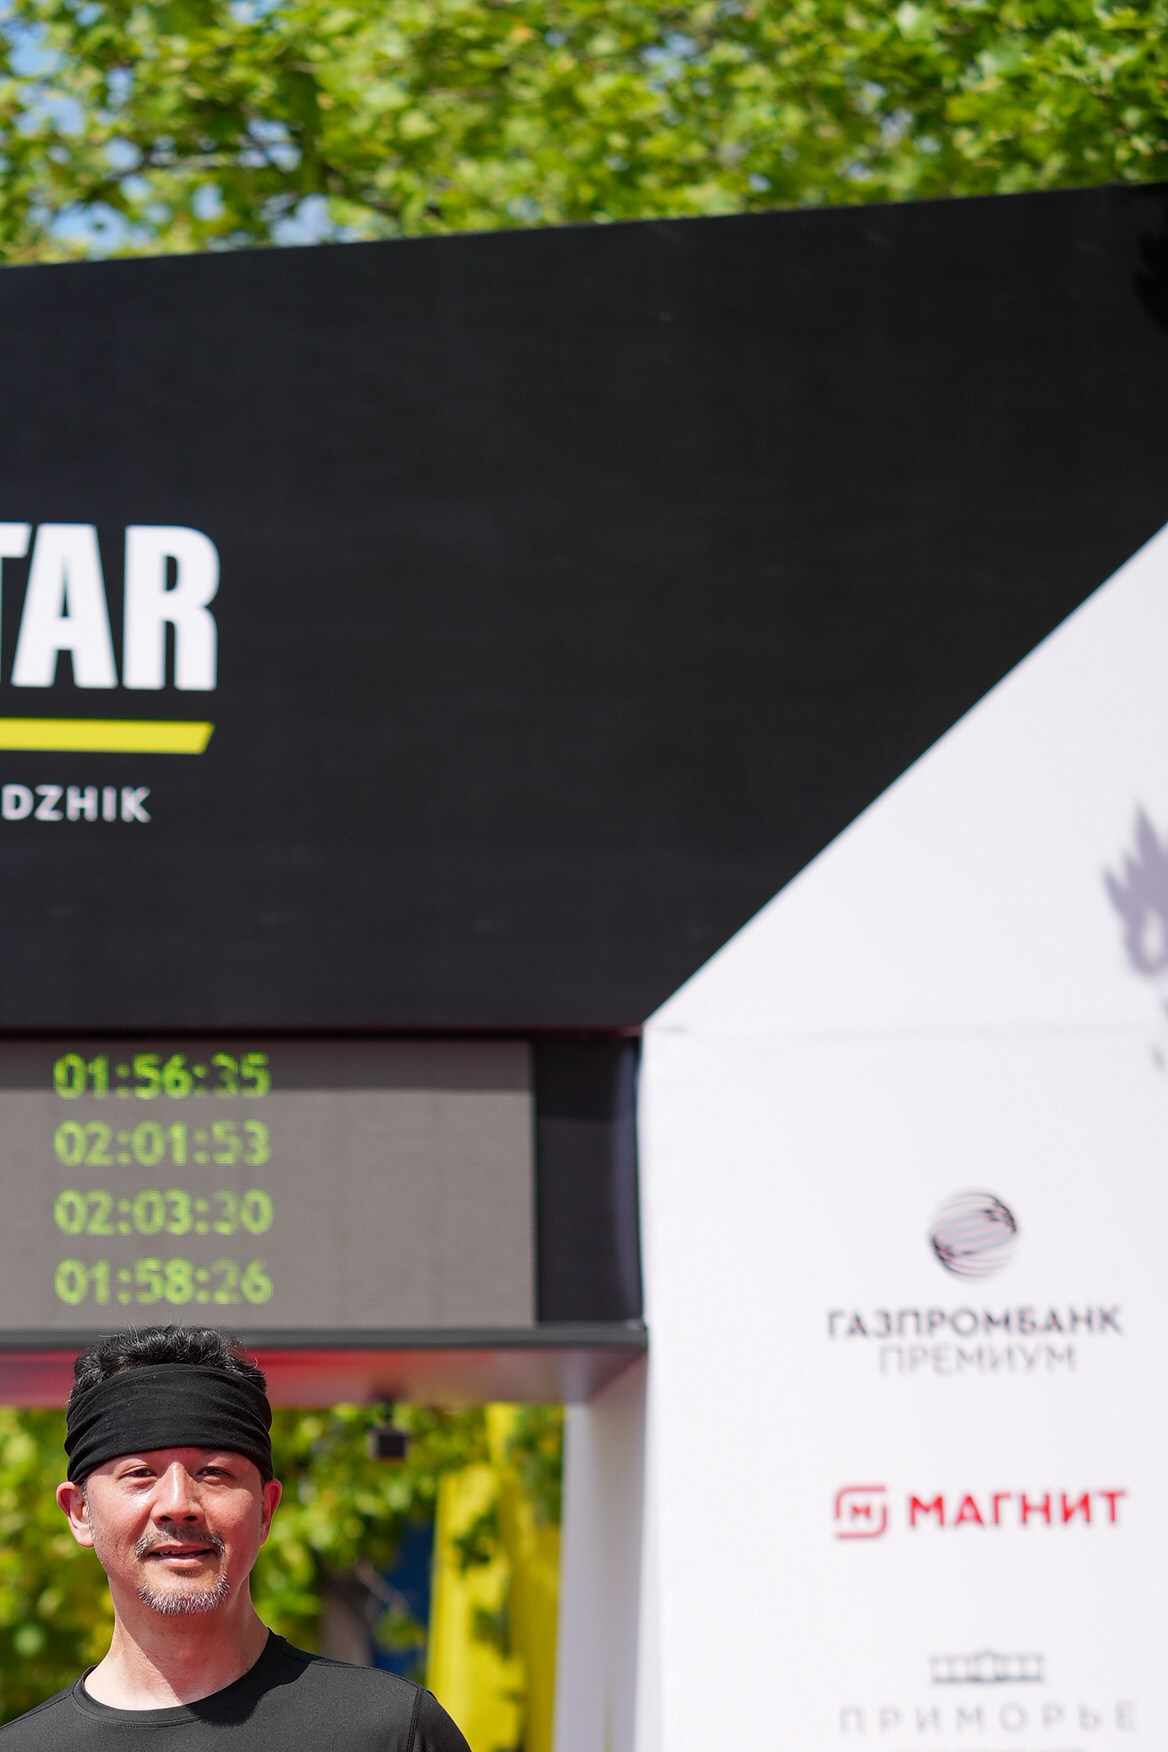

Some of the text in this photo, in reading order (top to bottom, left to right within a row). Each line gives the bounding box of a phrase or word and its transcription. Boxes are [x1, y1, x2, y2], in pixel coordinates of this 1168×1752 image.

[53, 1053, 272, 1100] 01:56:35
[53, 1119, 271, 1166] 02:01:53
[53, 1188, 273, 1235] 02:03:30
[54, 1257, 273, 1305] 01:58:26
[827, 1304, 1123, 1339] ГАЗПРОМБАНК
[878, 1342, 1078, 1375] ПРЕМИУМ
[909, 1489, 1127, 1528] МАГНИТ
